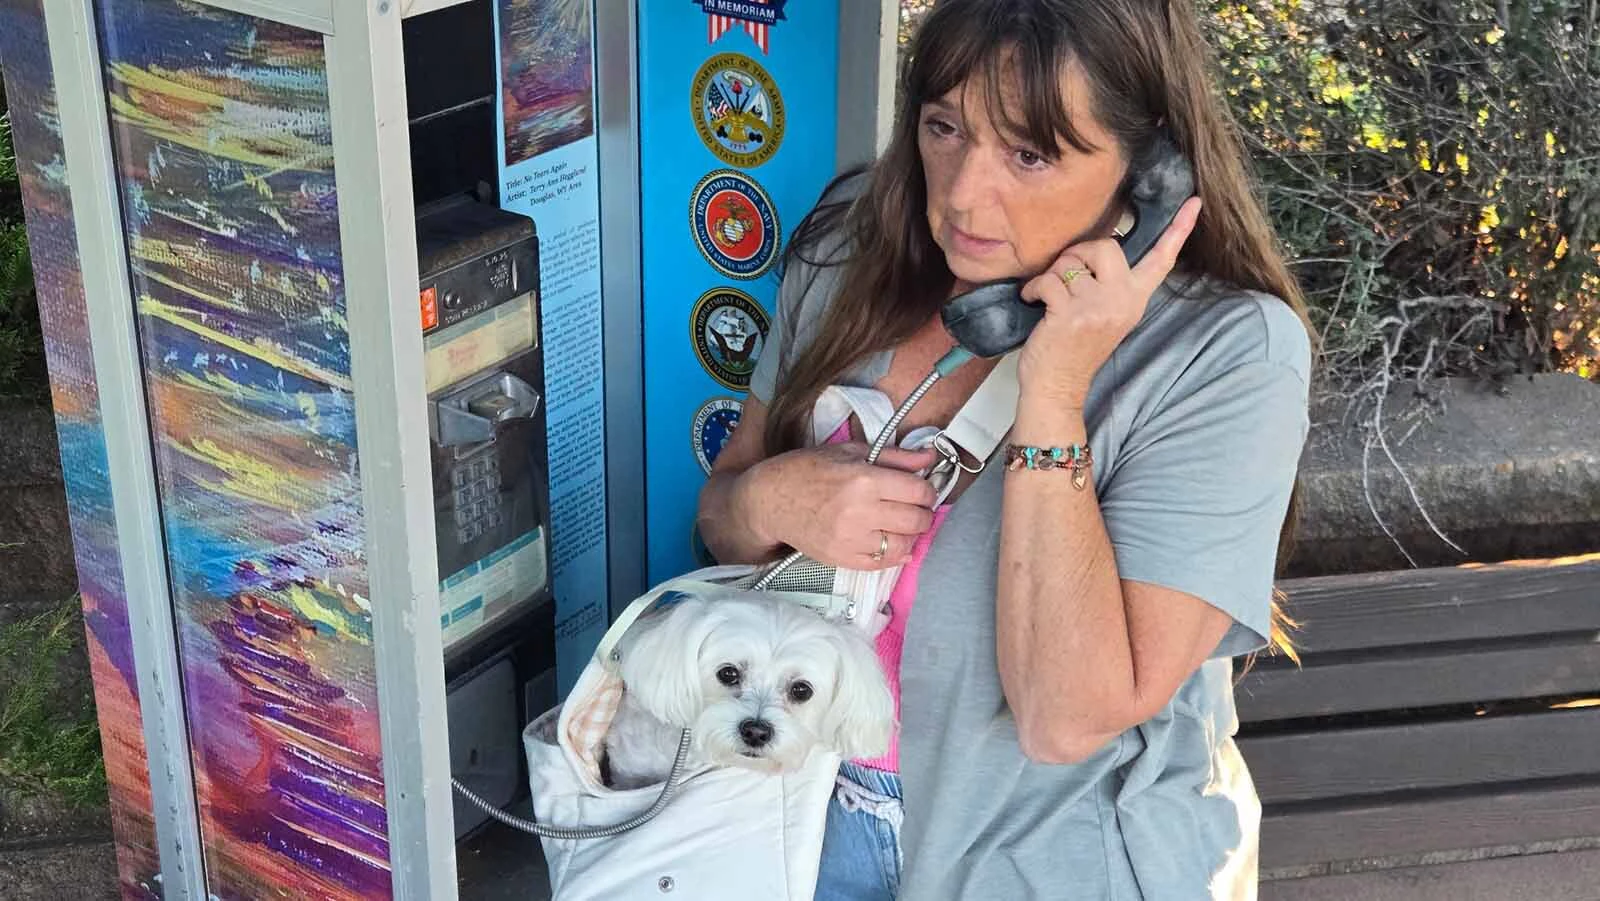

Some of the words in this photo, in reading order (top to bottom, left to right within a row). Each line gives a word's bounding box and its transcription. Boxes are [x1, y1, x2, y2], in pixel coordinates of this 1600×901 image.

[704, 0, 715, 8] IN
[718, 1, 775, 19] MEMORIAM
[505, 179, 523, 191] Title:
[523, 174, 532, 184] No
[532, 168, 550, 180] Tears
[550, 161, 568, 173] Again
[529, 182, 546, 194] Terry
[696, 179, 737, 216] DEPARTMENT
[695, 402, 718, 452] DEPARTMENT
[721, 400, 731, 409] OF
